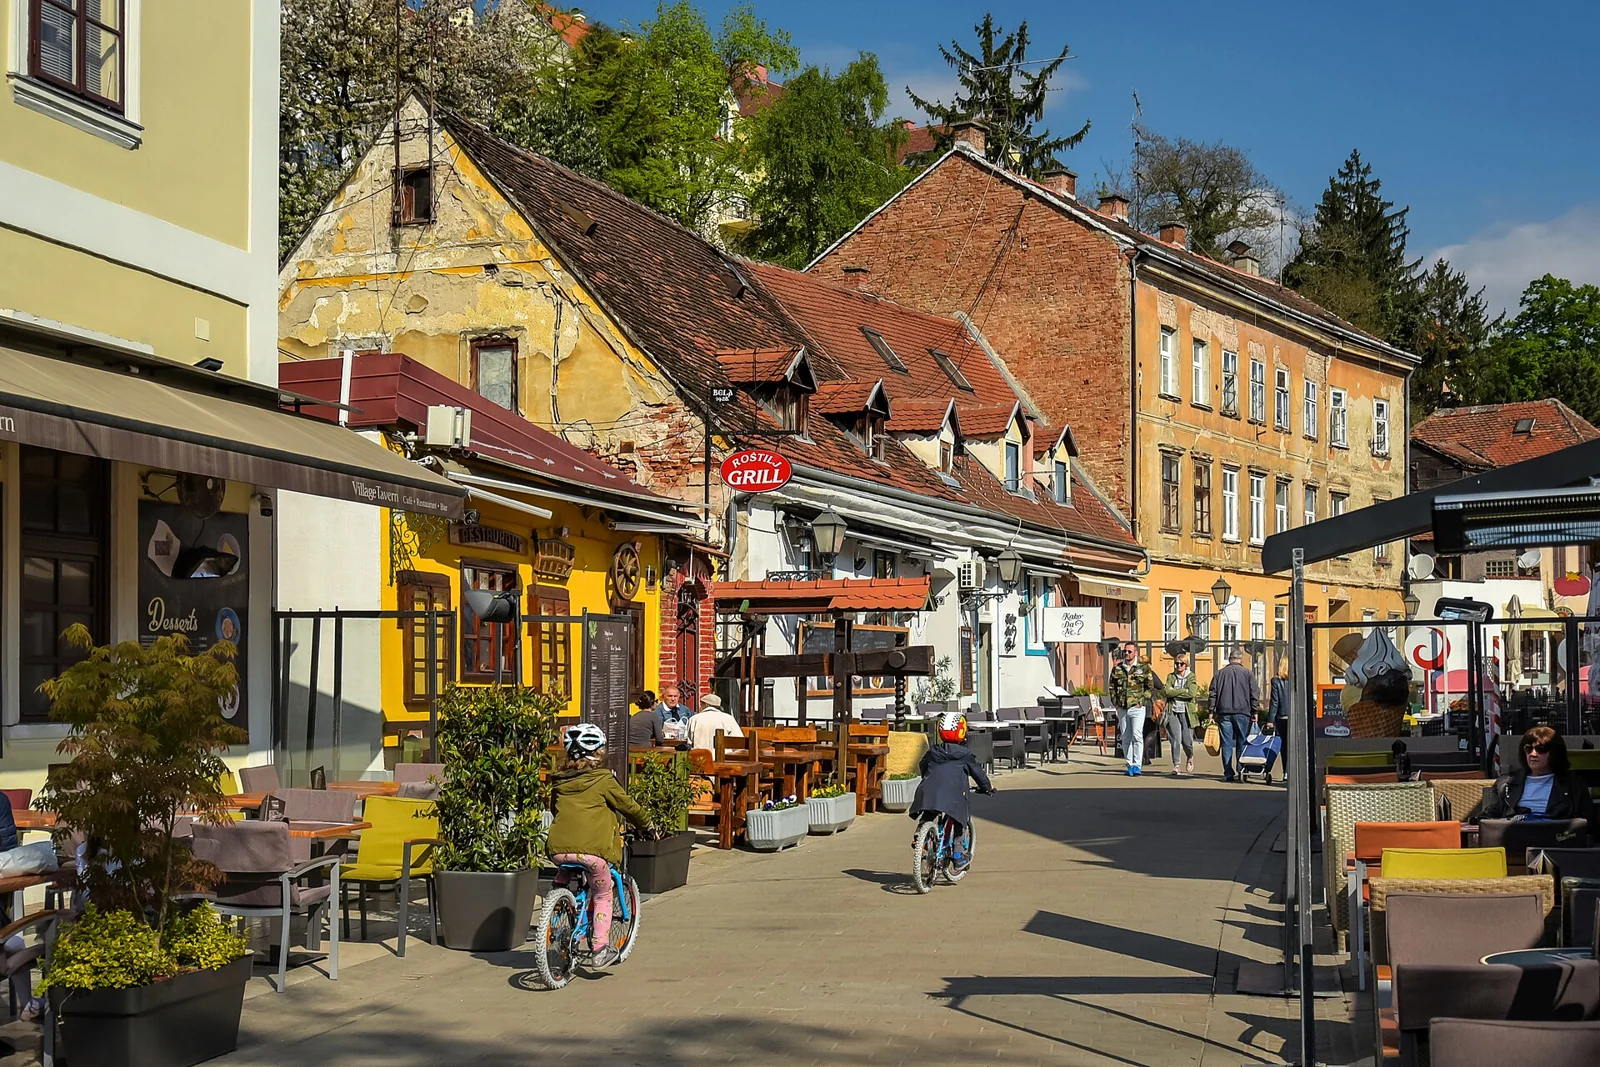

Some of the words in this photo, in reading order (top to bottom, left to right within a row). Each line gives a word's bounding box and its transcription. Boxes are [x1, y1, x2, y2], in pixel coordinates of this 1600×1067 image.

[732, 452, 782, 468] ROŠTILJ
[727, 469, 784, 485] GRILL
[440, 503, 448, 512] Bar
[460, 526, 522, 552] RESTAURANT
[148, 597, 198, 633] Desserts
